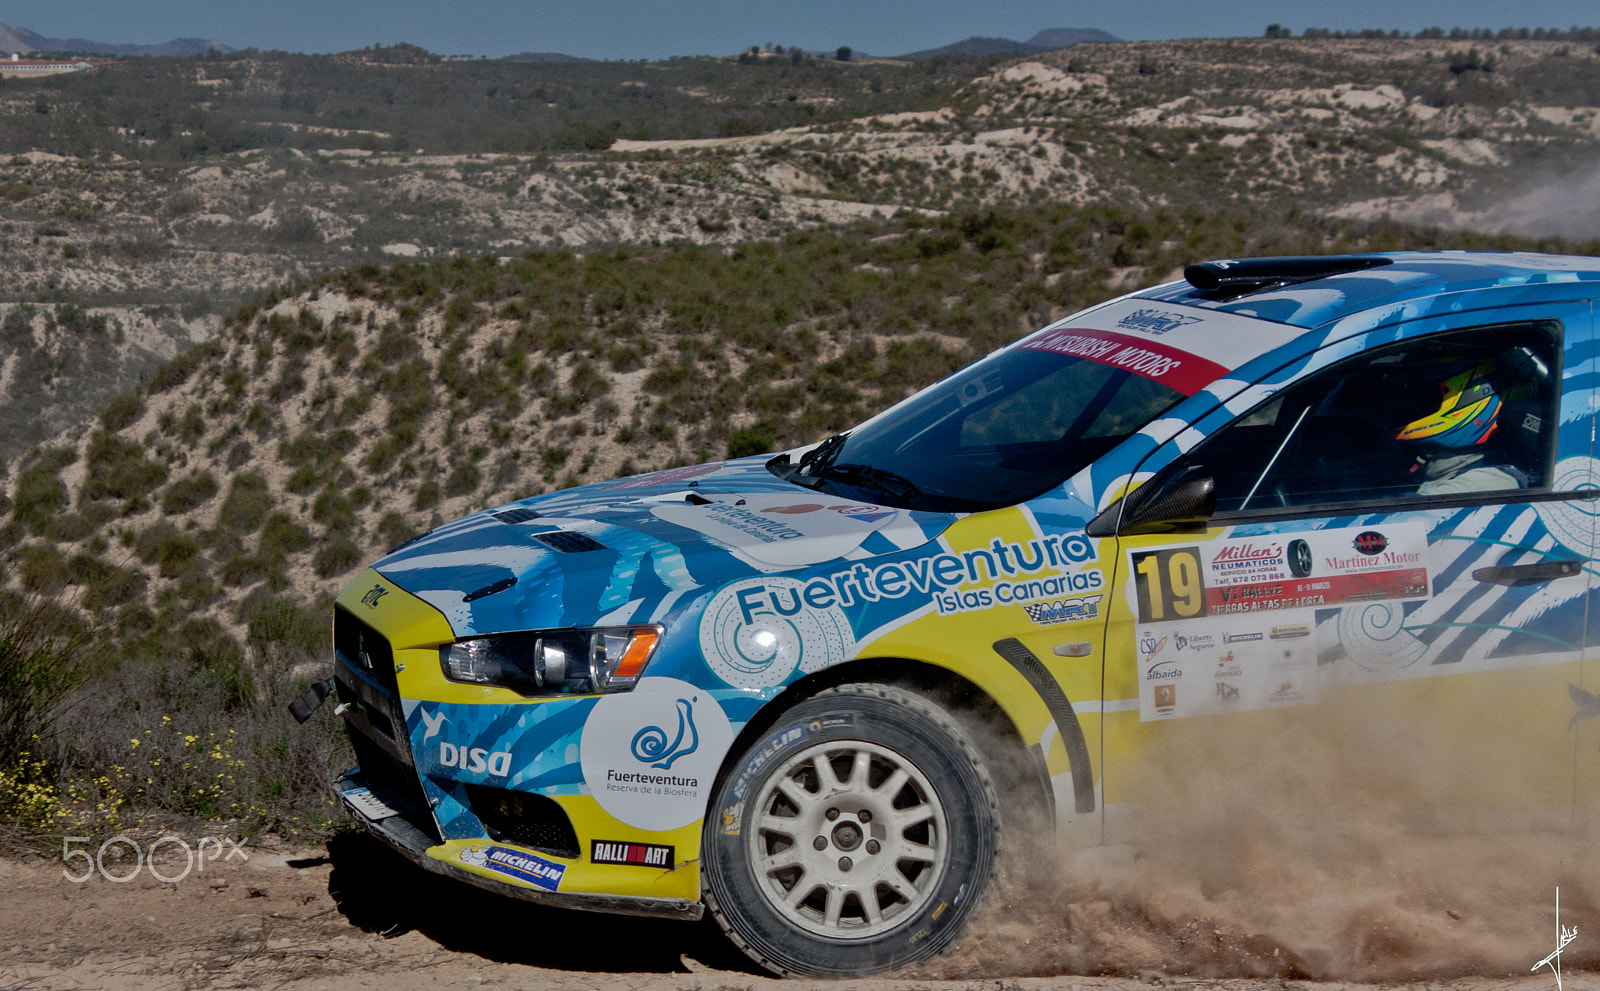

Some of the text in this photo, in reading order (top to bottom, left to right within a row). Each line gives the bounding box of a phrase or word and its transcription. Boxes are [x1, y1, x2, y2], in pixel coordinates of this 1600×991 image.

[1105, 346, 1182, 377] MOTORS
[1212, 558, 1284, 571] NEUMATICOS
[1383, 551, 1421, 564] Motor
[736, 533, 1096, 625] Fuerteventura
[1137, 552, 1202, 619] 19
[1233, 576, 1249, 584] 672
[1251, 574, 1267, 582] 073
[936, 571, 1102, 613] Islas Canarias
[1241, 584, 1283, 599] RALLYE
[1211, 601, 1250, 616] TIERRAS
[1252, 598, 1281, 613] ALTAS
[1189, 634, 1213, 643] Liberty
[1146, 668, 1183, 681] albaida
[607, 769, 698, 787] Fuerteventura
[606, 783, 698, 798] Reserva de la Biosfera
[490, 850, 563, 882] MICHELIN
